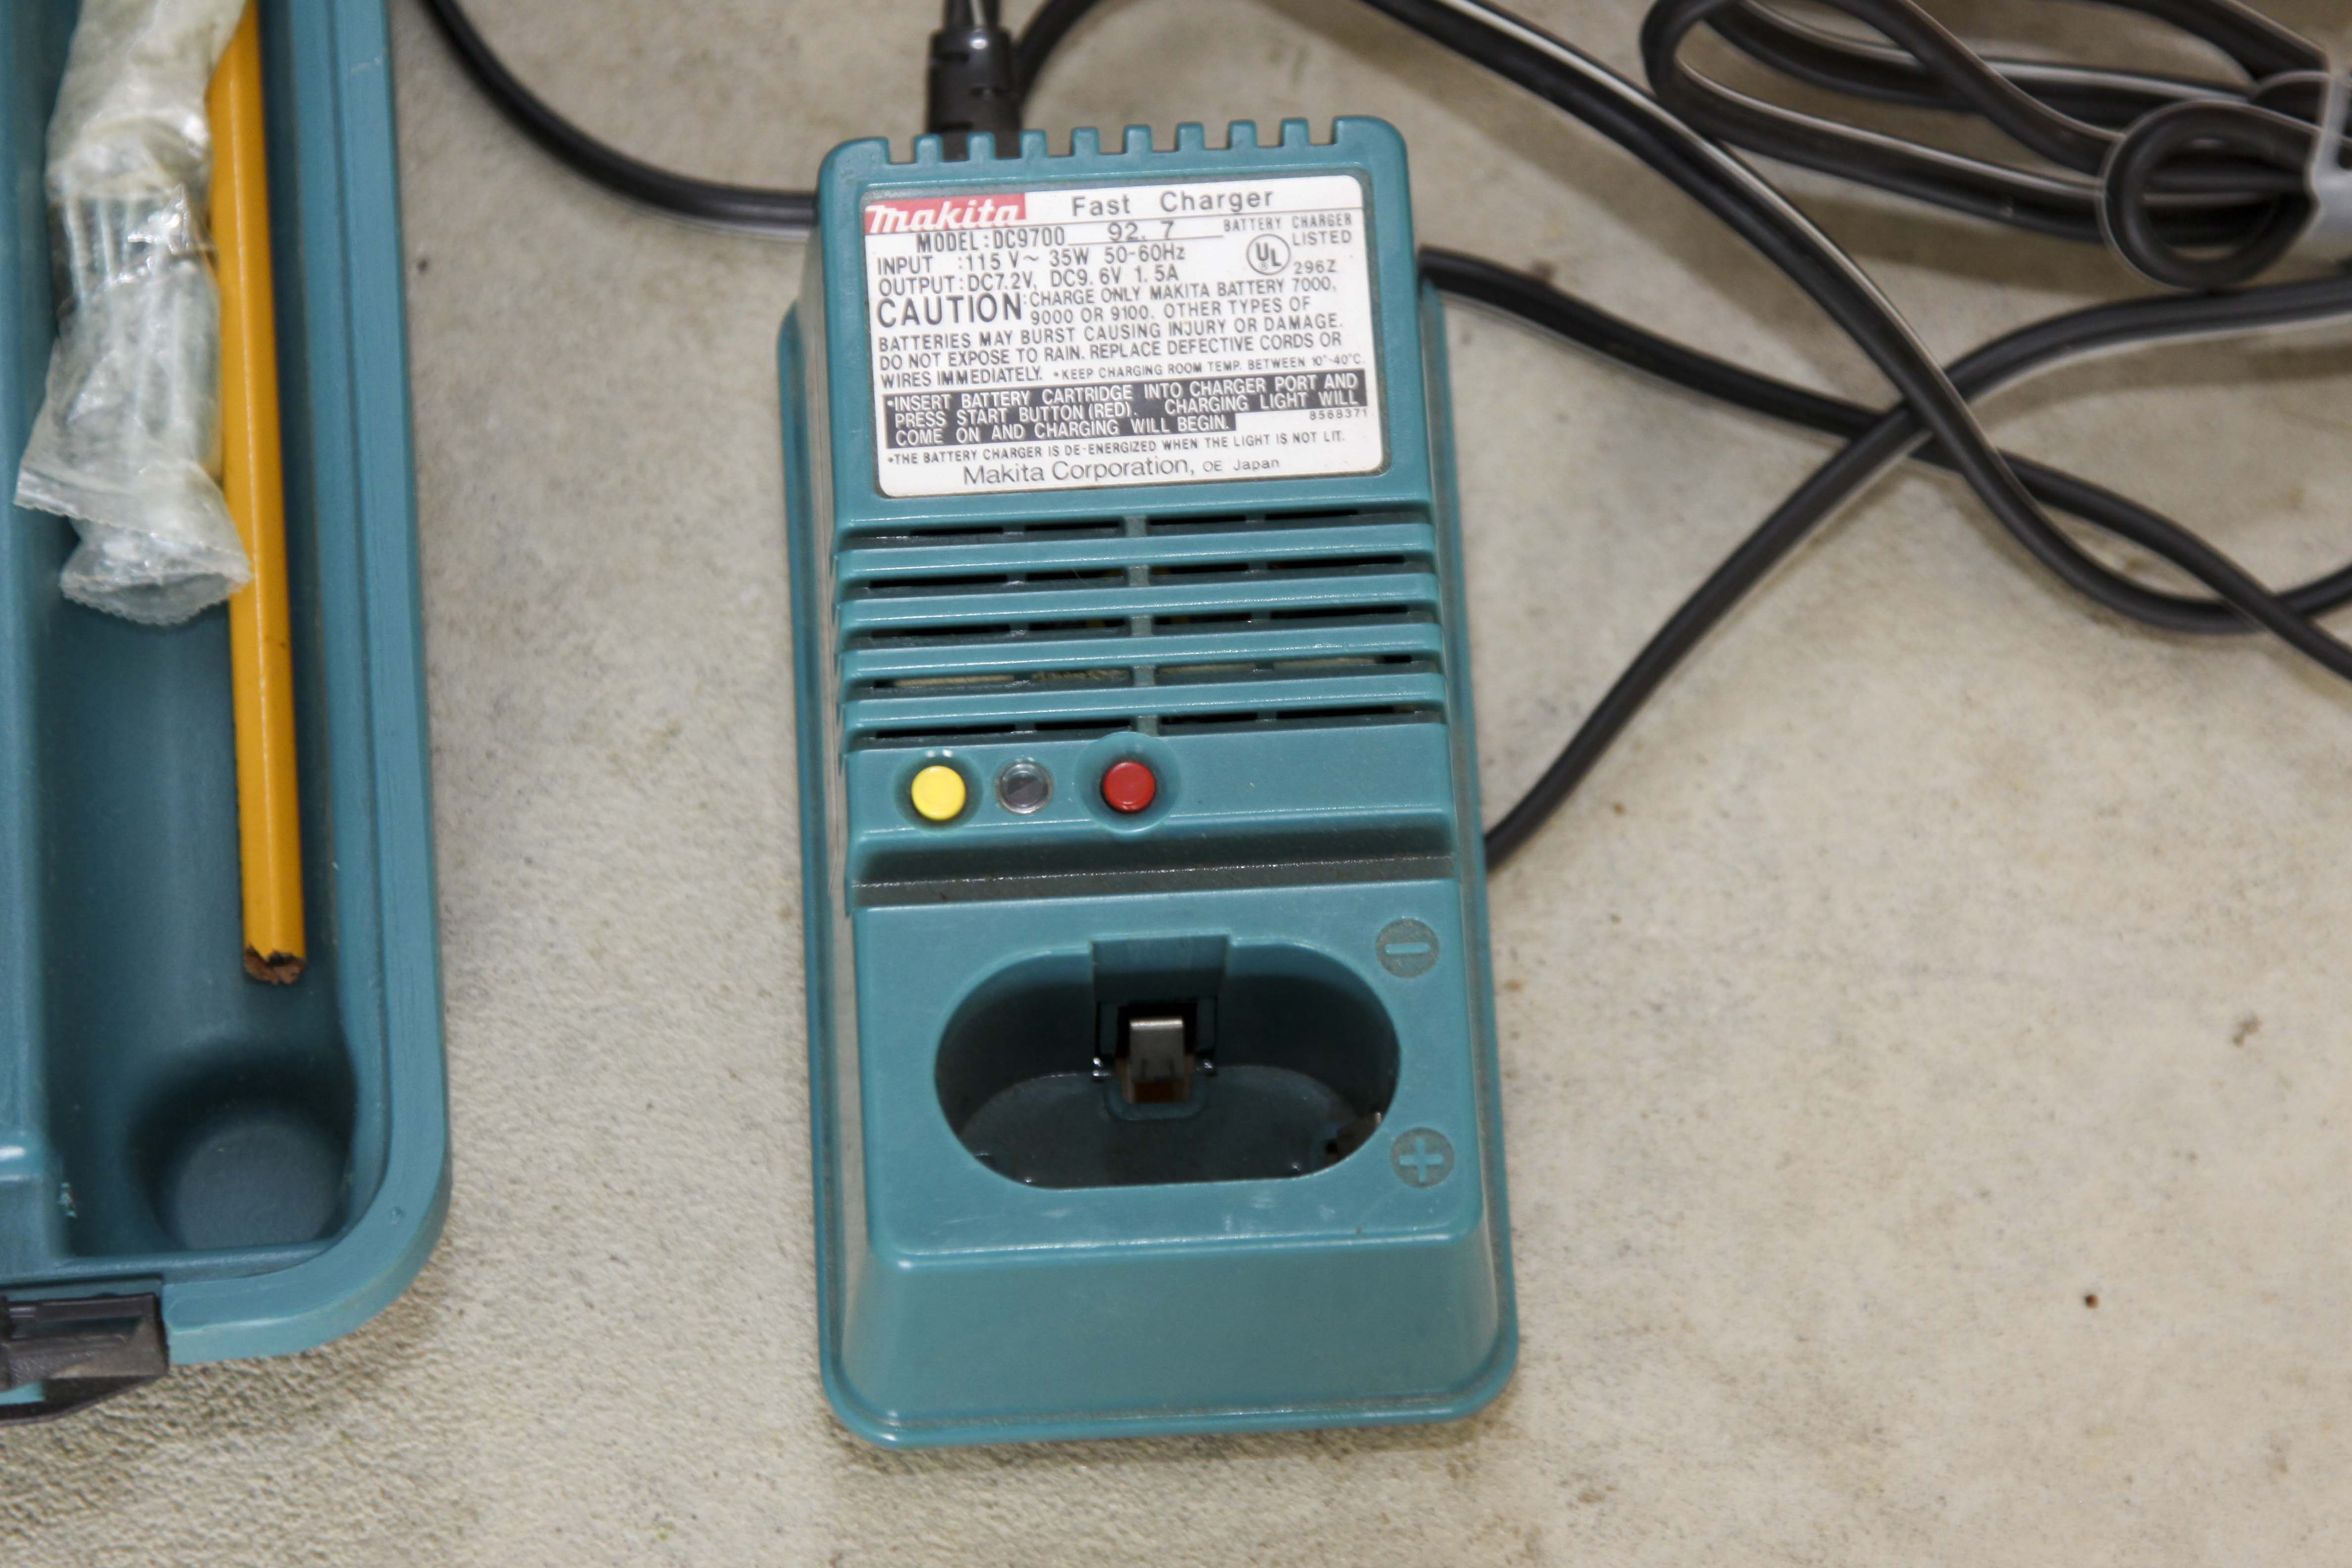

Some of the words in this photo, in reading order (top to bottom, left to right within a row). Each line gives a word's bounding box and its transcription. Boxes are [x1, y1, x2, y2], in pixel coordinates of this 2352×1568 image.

[865, 198, 1018, 234] makita
[1072, 194, 1130, 216] Fast
[1160, 190, 1273, 213] Charger
[1224, 217, 1281, 232] BATTERY
[1291, 212, 1352, 228] CHARGER
[1291, 230, 1351, 246] LISTED
[1049, 247, 1089, 267] 35W
[1104, 243, 1185, 264] 50-60Hz
[1256, 242, 1281, 267] UL
[1294, 259, 1336, 274] 296Z
[1101, 286, 1140, 303] ONLY
[1150, 282, 1210, 300] MAKITA
[1217, 278, 1284, 296] BATTERY
[1291, 276, 1336, 292] 7000,
[1030, 308, 1073, 325] 9000
[1080, 307, 1103, 323] OR
[1111, 304, 1154, 321] 9100.
[1164, 300, 1221, 318] OTHER
[1228, 297, 1282, 314] TYPES
[1289, 296, 1311, 311] OF
[879, 333, 971, 352] BATTERIES
[979, 330, 1013, 346] MAY
[1021, 327, 1075, 344] BURST
[1084, 322, 1161, 342] CAUSING
[1169, 319, 1226, 336] INJURY
[1234, 317, 1257, 333] OR
[1264, 312, 1343, 331] DAMAGE.
[880, 354, 902, 371] DO
[908, 352, 941, 368] NOT
[948, 348, 1010, 367] EXPOSE
[1016, 347, 1037, 363] TO
[1044, 345, 1085, 362] RAIN.
[1089, 341, 1161, 359] REPLACE
[1167, 336, 1254, 355] DEFECTIVE
[1260, 333, 1314, 350] CORDS
[1320, 331, 1342, 347] OR
[881, 371, 931, 389] WIRES
[937, 366, 1042, 386] IMMEDIATELY.
[1099, 364, 1163, 379] CHARGING
[1168, 362, 1202, 375] ROOM
[1207, 360, 1242, 372] TEMP.
[1248, 356, 1305, 370] BETWEEN
[961, 391, 1030, 408] BATTERY
[1042, 385, 1133, 405] CARTRIDGE
[1144, 382, 1182, 399] INTO
[1190, 377, 1266, 396] CHARGER
[1274, 375, 1317, 392] PORT
[1324, 373, 1357, 389] AND
[895, 411, 946, 428] PRESS
[957, 408, 1007, 426] START
[1165, 395, 1248, 415] CHARGING
[1261, 392, 1307, 409] LIGHT
[1319, 390, 1358, 406] WILL
[1310, 408, 1367, 420] 8568371
[896, 429, 942, 446] COME
[956, 427, 980, 443] ON
[992, 424, 1025, 440] AND
[1034, 419, 1119, 439] CHARGING
[1130, 418, 1170, 434] WILL
[1177, 415, 1228, 432] BEGIN.
[924, 449, 977, 463] BATTERY
[983, 446, 1041, 460] CHARGER
[1048, 445, 1059, 456] IS
[1065, 441, 1156, 456] DE-ENERGIZED
[1162, 438, 1198, 450] WHEN
[1205, 436, 1227, 447] THE
[1234, 434, 1270, 446] LIGHT
[1276, 433, 1287, 444] IS
[1293, 432, 1317, 443] NOT
[1324, 431, 1345, 442] LIT.
[964, 463, 1044, 485] Makita
[1052, 455, 1194, 481] Corporation,
[1203, 460, 1222, 472] OE
[1233, 458, 1279, 472] Japan
